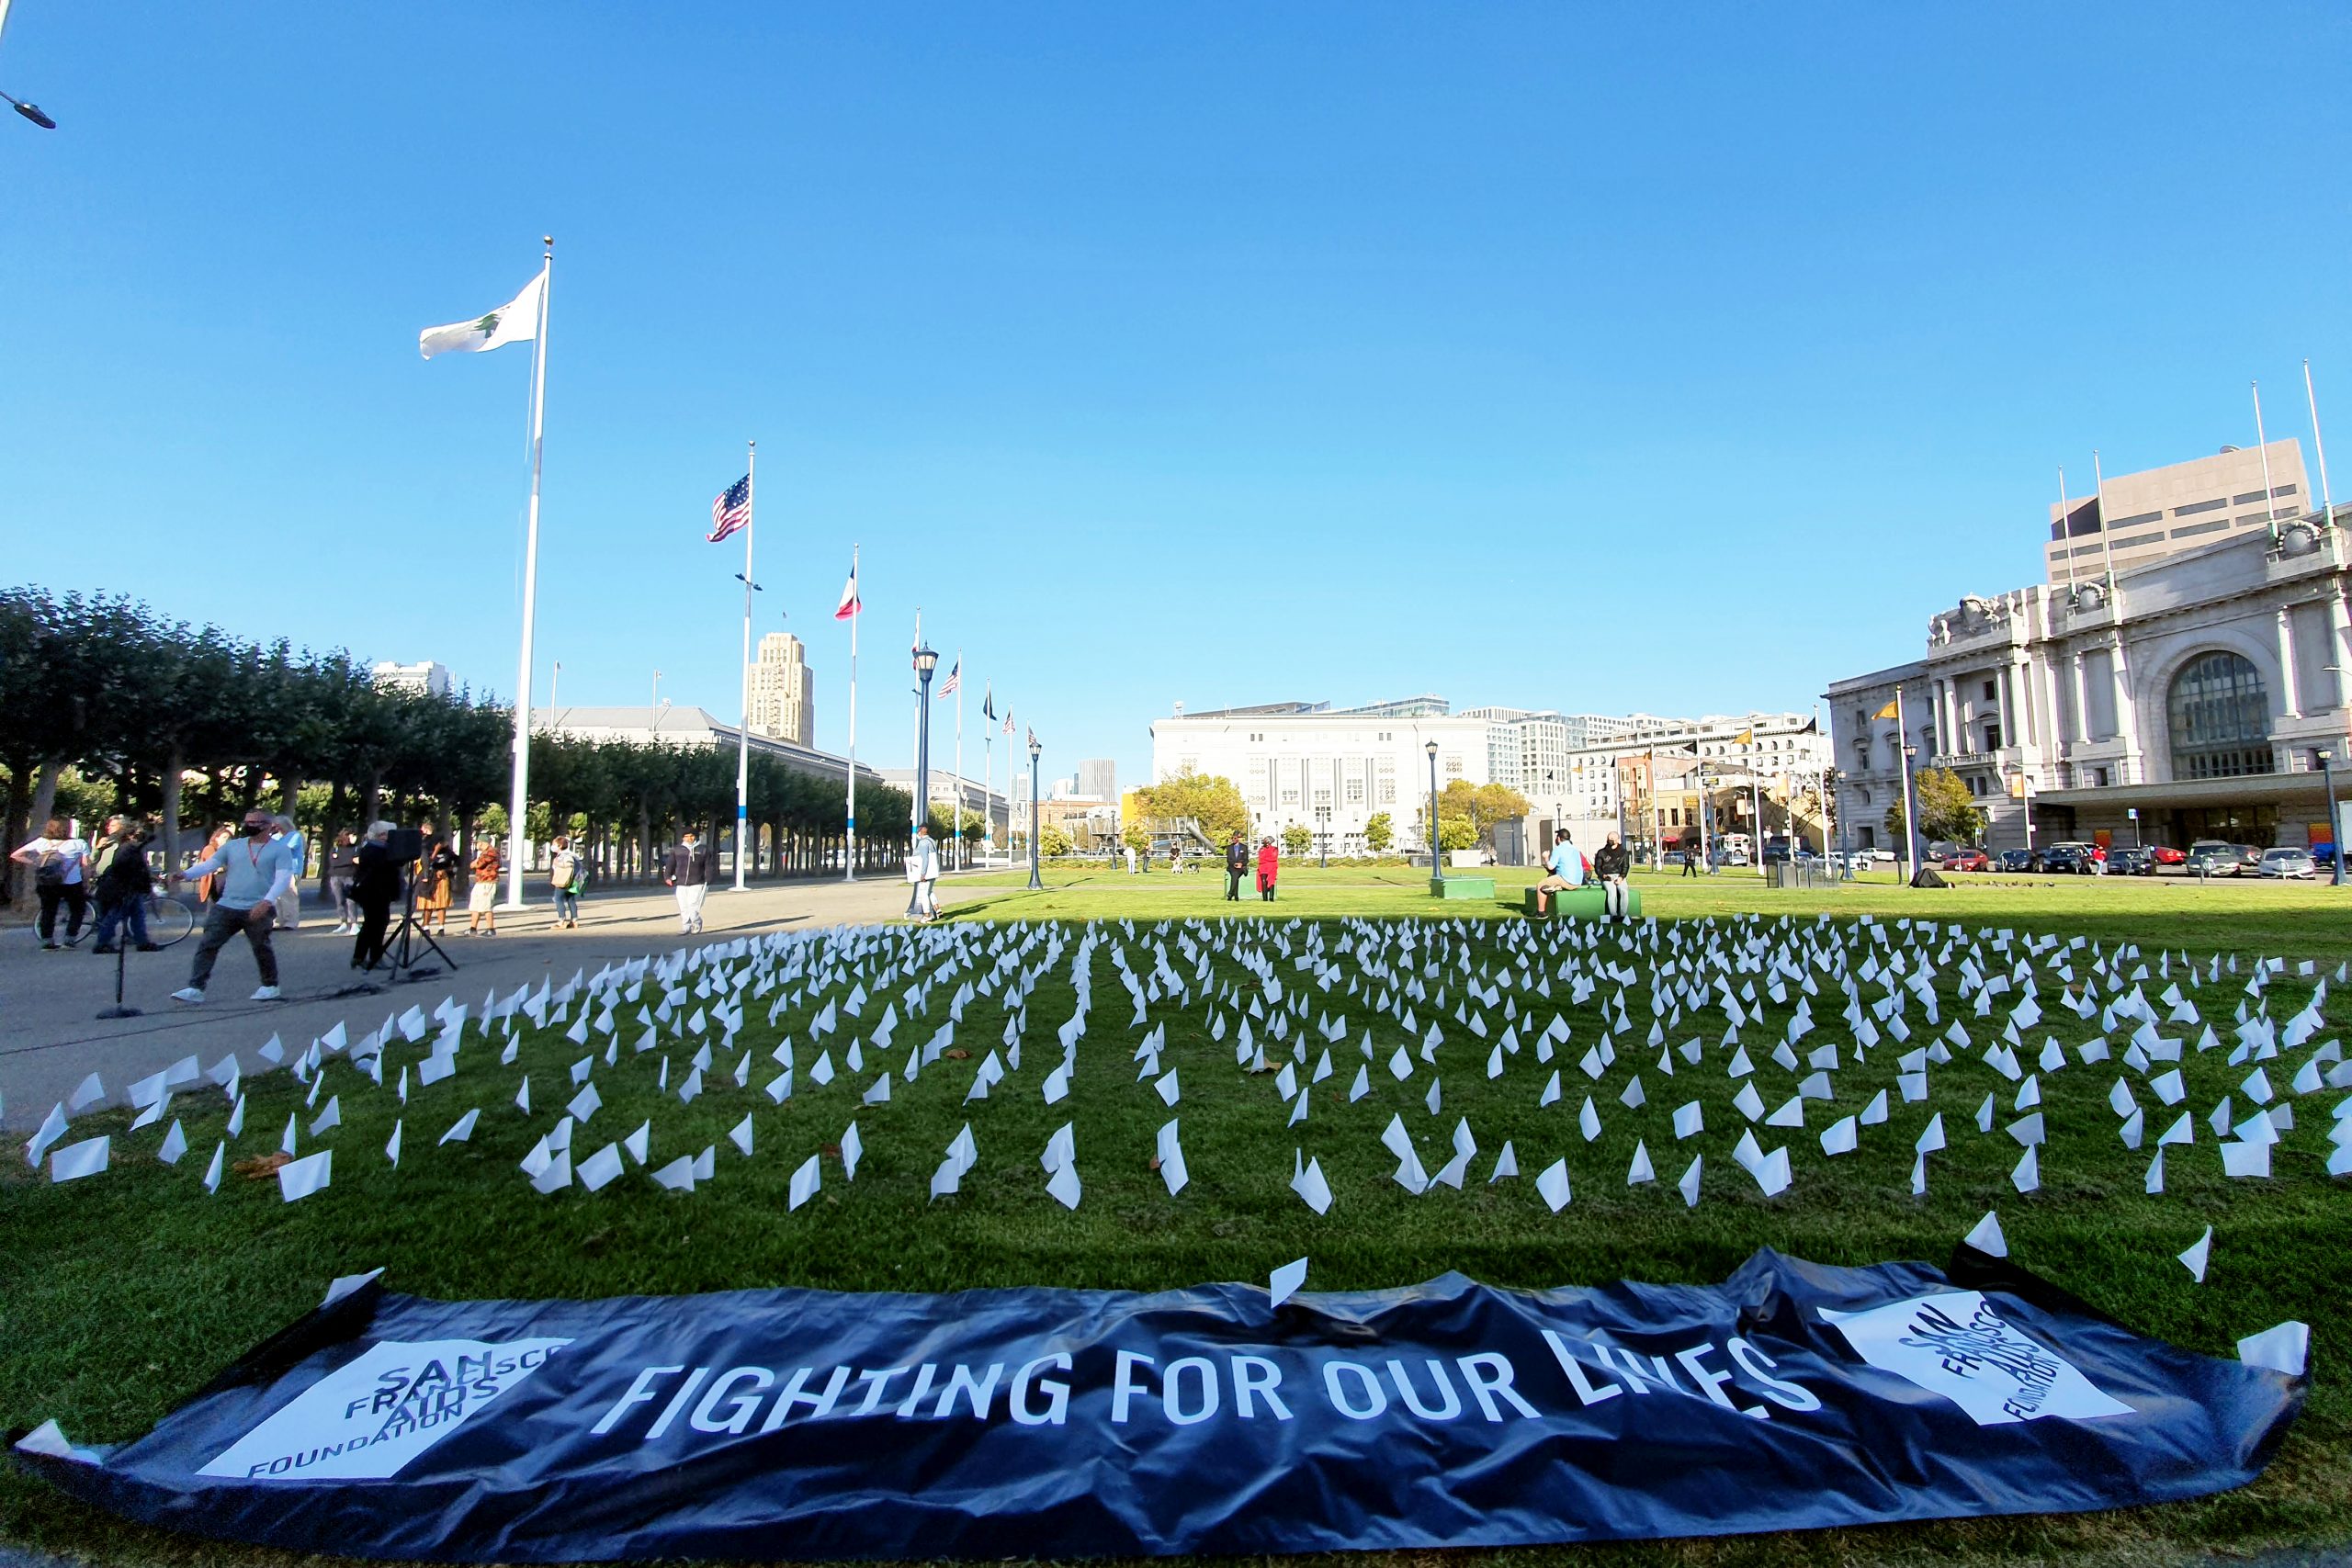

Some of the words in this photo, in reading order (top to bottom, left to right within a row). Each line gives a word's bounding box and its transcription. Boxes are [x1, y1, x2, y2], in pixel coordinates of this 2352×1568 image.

[1898, 1303, 1966, 1356] SAN
[374, 1350, 492, 1395] SAN
[591, 1352, 1073, 1439] FIGHTING
[1111, 1349, 1294, 1425] FOR
[1322, 1352, 1543, 1423] OUR
[1540, 1329, 1822, 1420] LIVES
[385, 1377, 500, 1427] AIDS
[246, 1404, 462, 1479] FOUNDATION
